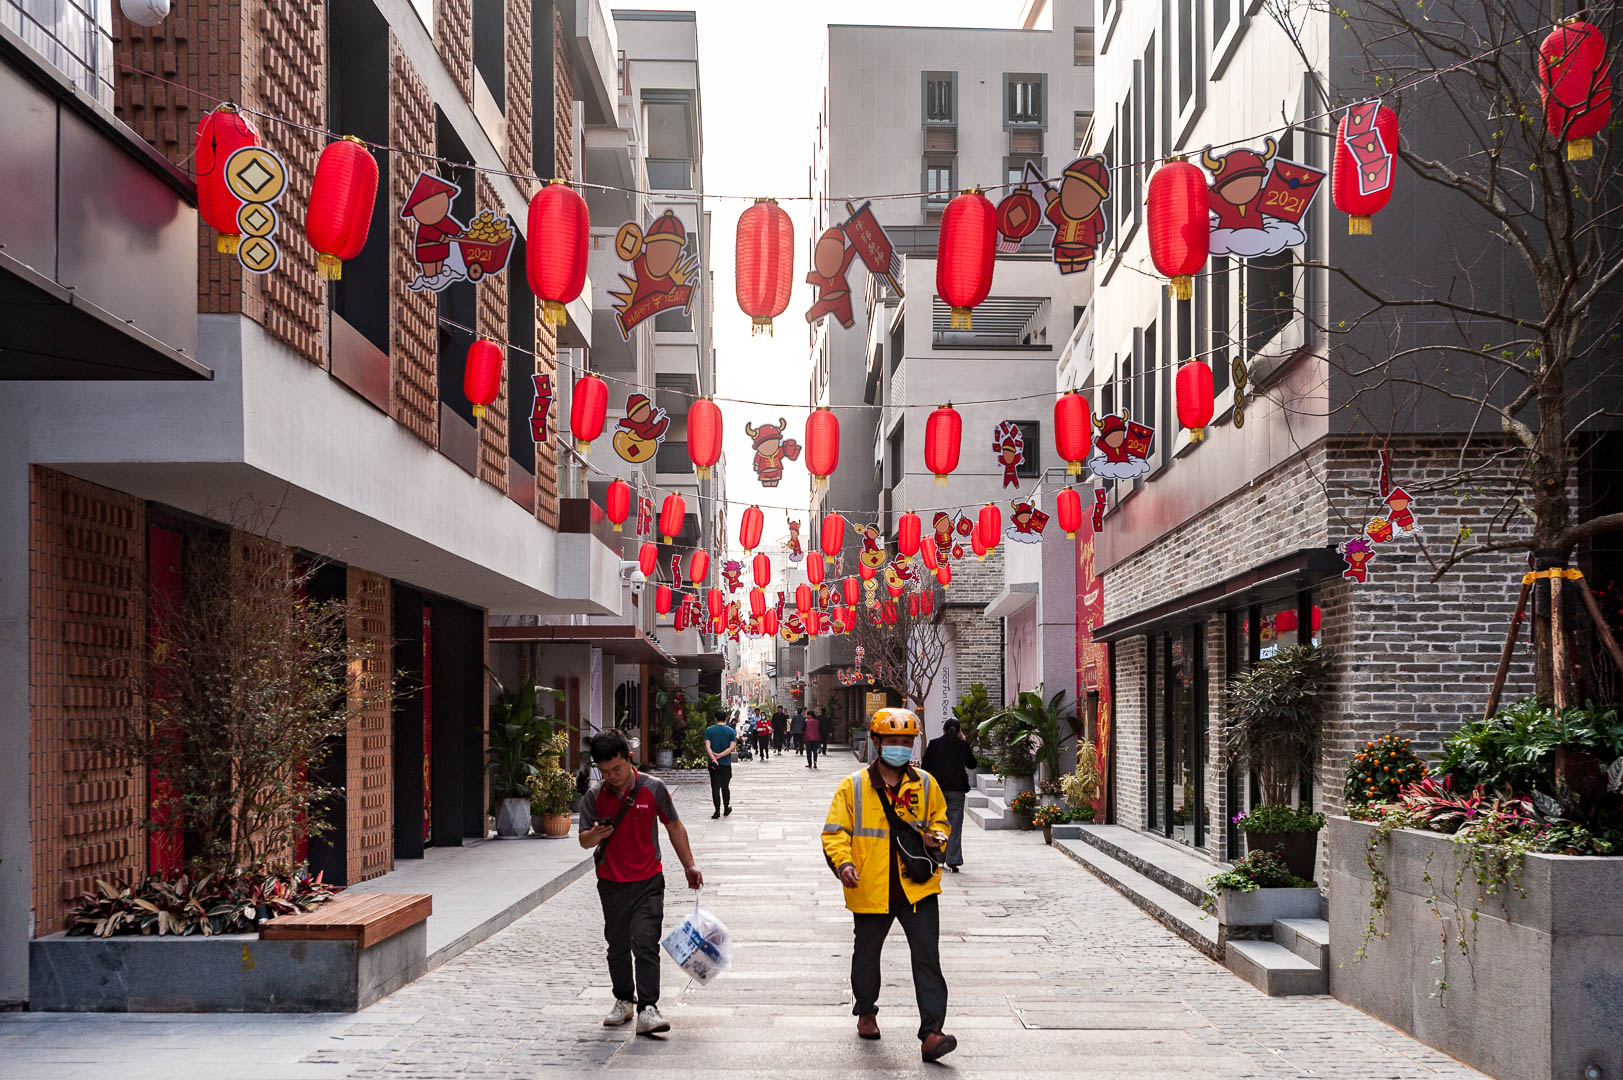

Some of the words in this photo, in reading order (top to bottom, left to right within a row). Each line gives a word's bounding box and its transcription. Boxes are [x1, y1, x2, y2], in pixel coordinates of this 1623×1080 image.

[1265, 190, 1305, 214] 2021
[467, 247, 492, 261] 2021
[626, 301, 651, 324] HAPPY
[663, 290, 685, 303] YEAR
[1127, 439, 1147, 453] 2021
[941, 699, 949, 716] Rice
